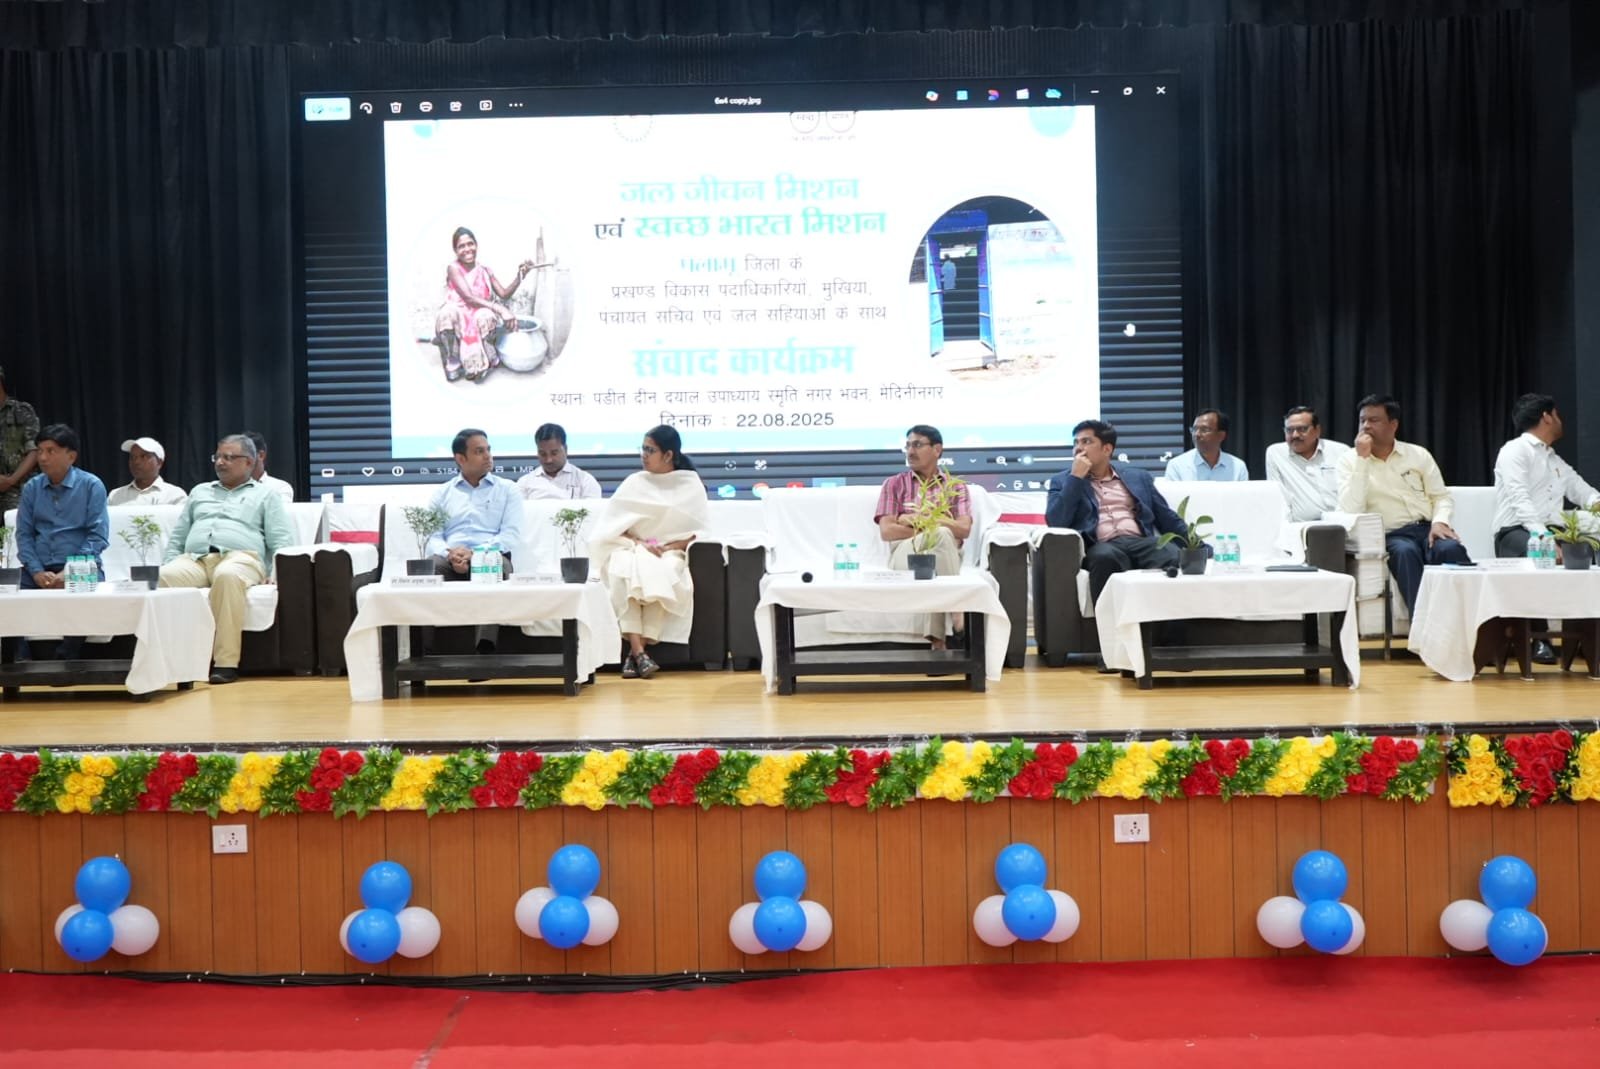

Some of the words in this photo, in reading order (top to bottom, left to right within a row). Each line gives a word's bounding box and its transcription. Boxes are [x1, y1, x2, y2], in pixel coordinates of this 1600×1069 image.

[729, 96, 762, 106] copy.jpg
[619, 180, 675, 204] जल
[683, 174, 766, 204] जीवन
[774, 172, 860, 202] मिशन
[594, 217, 625, 240] एवं
[634, 214, 711, 239] स्वच्छ
[718, 212, 793, 237] भारत
[801, 205, 887, 236] मिशन
[744, 253, 781, 272] जिला
[611, 284, 656, 299] प्रखण्ड
[664, 280, 710, 298] विकास
[599, 307, 648, 325] पंचायत
[656, 305, 695, 325] सचिव
[703, 306, 722, 325] एवं
[731, 308, 757, 323] जल
[859, 305, 888, 321] साथ
[633, 338, 720, 377] संवाद
[728, 336, 855, 376] कार्यक्रम
[633, 387, 657, 405] दीन
[665, 391, 699, 404] दयाल
[708, 389, 760, 404] उपाध्याय
[768, 384, 798, 407] स्मृति
[806, 388, 832, 401] नगर
[736, 412, 835, 428] 22.08.2025
